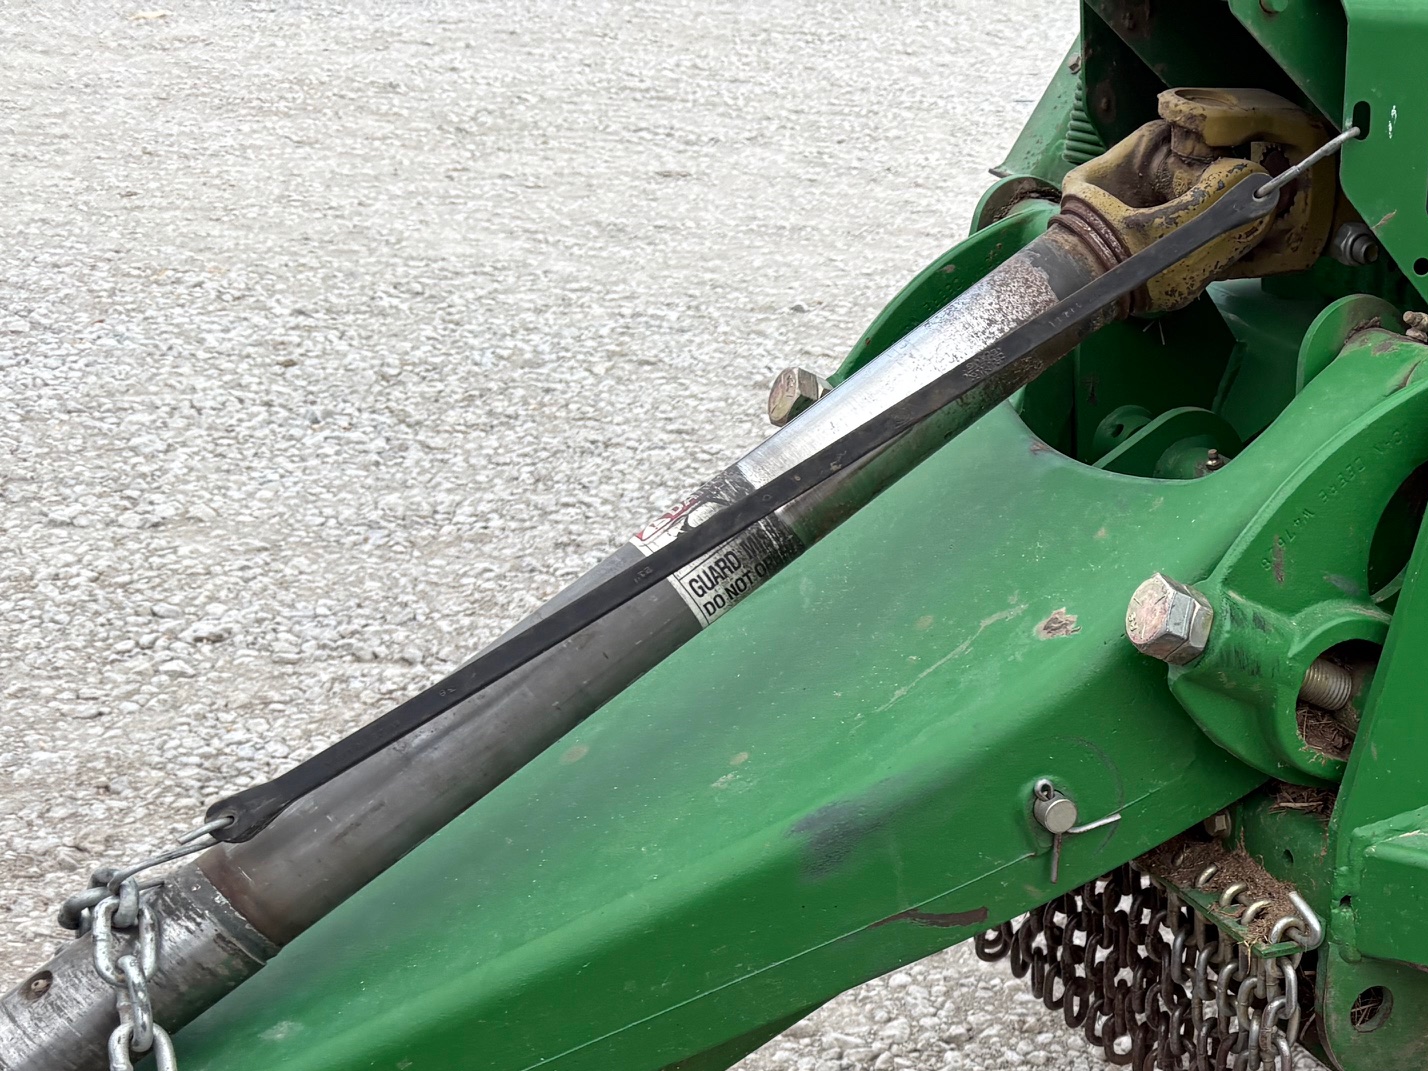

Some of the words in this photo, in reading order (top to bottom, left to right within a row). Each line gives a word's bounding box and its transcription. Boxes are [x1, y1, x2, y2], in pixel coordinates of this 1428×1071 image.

[688, 550, 742, 598] GUARD
[703, 593, 726, 616] DO
[724, 569, 754, 600] NOT
